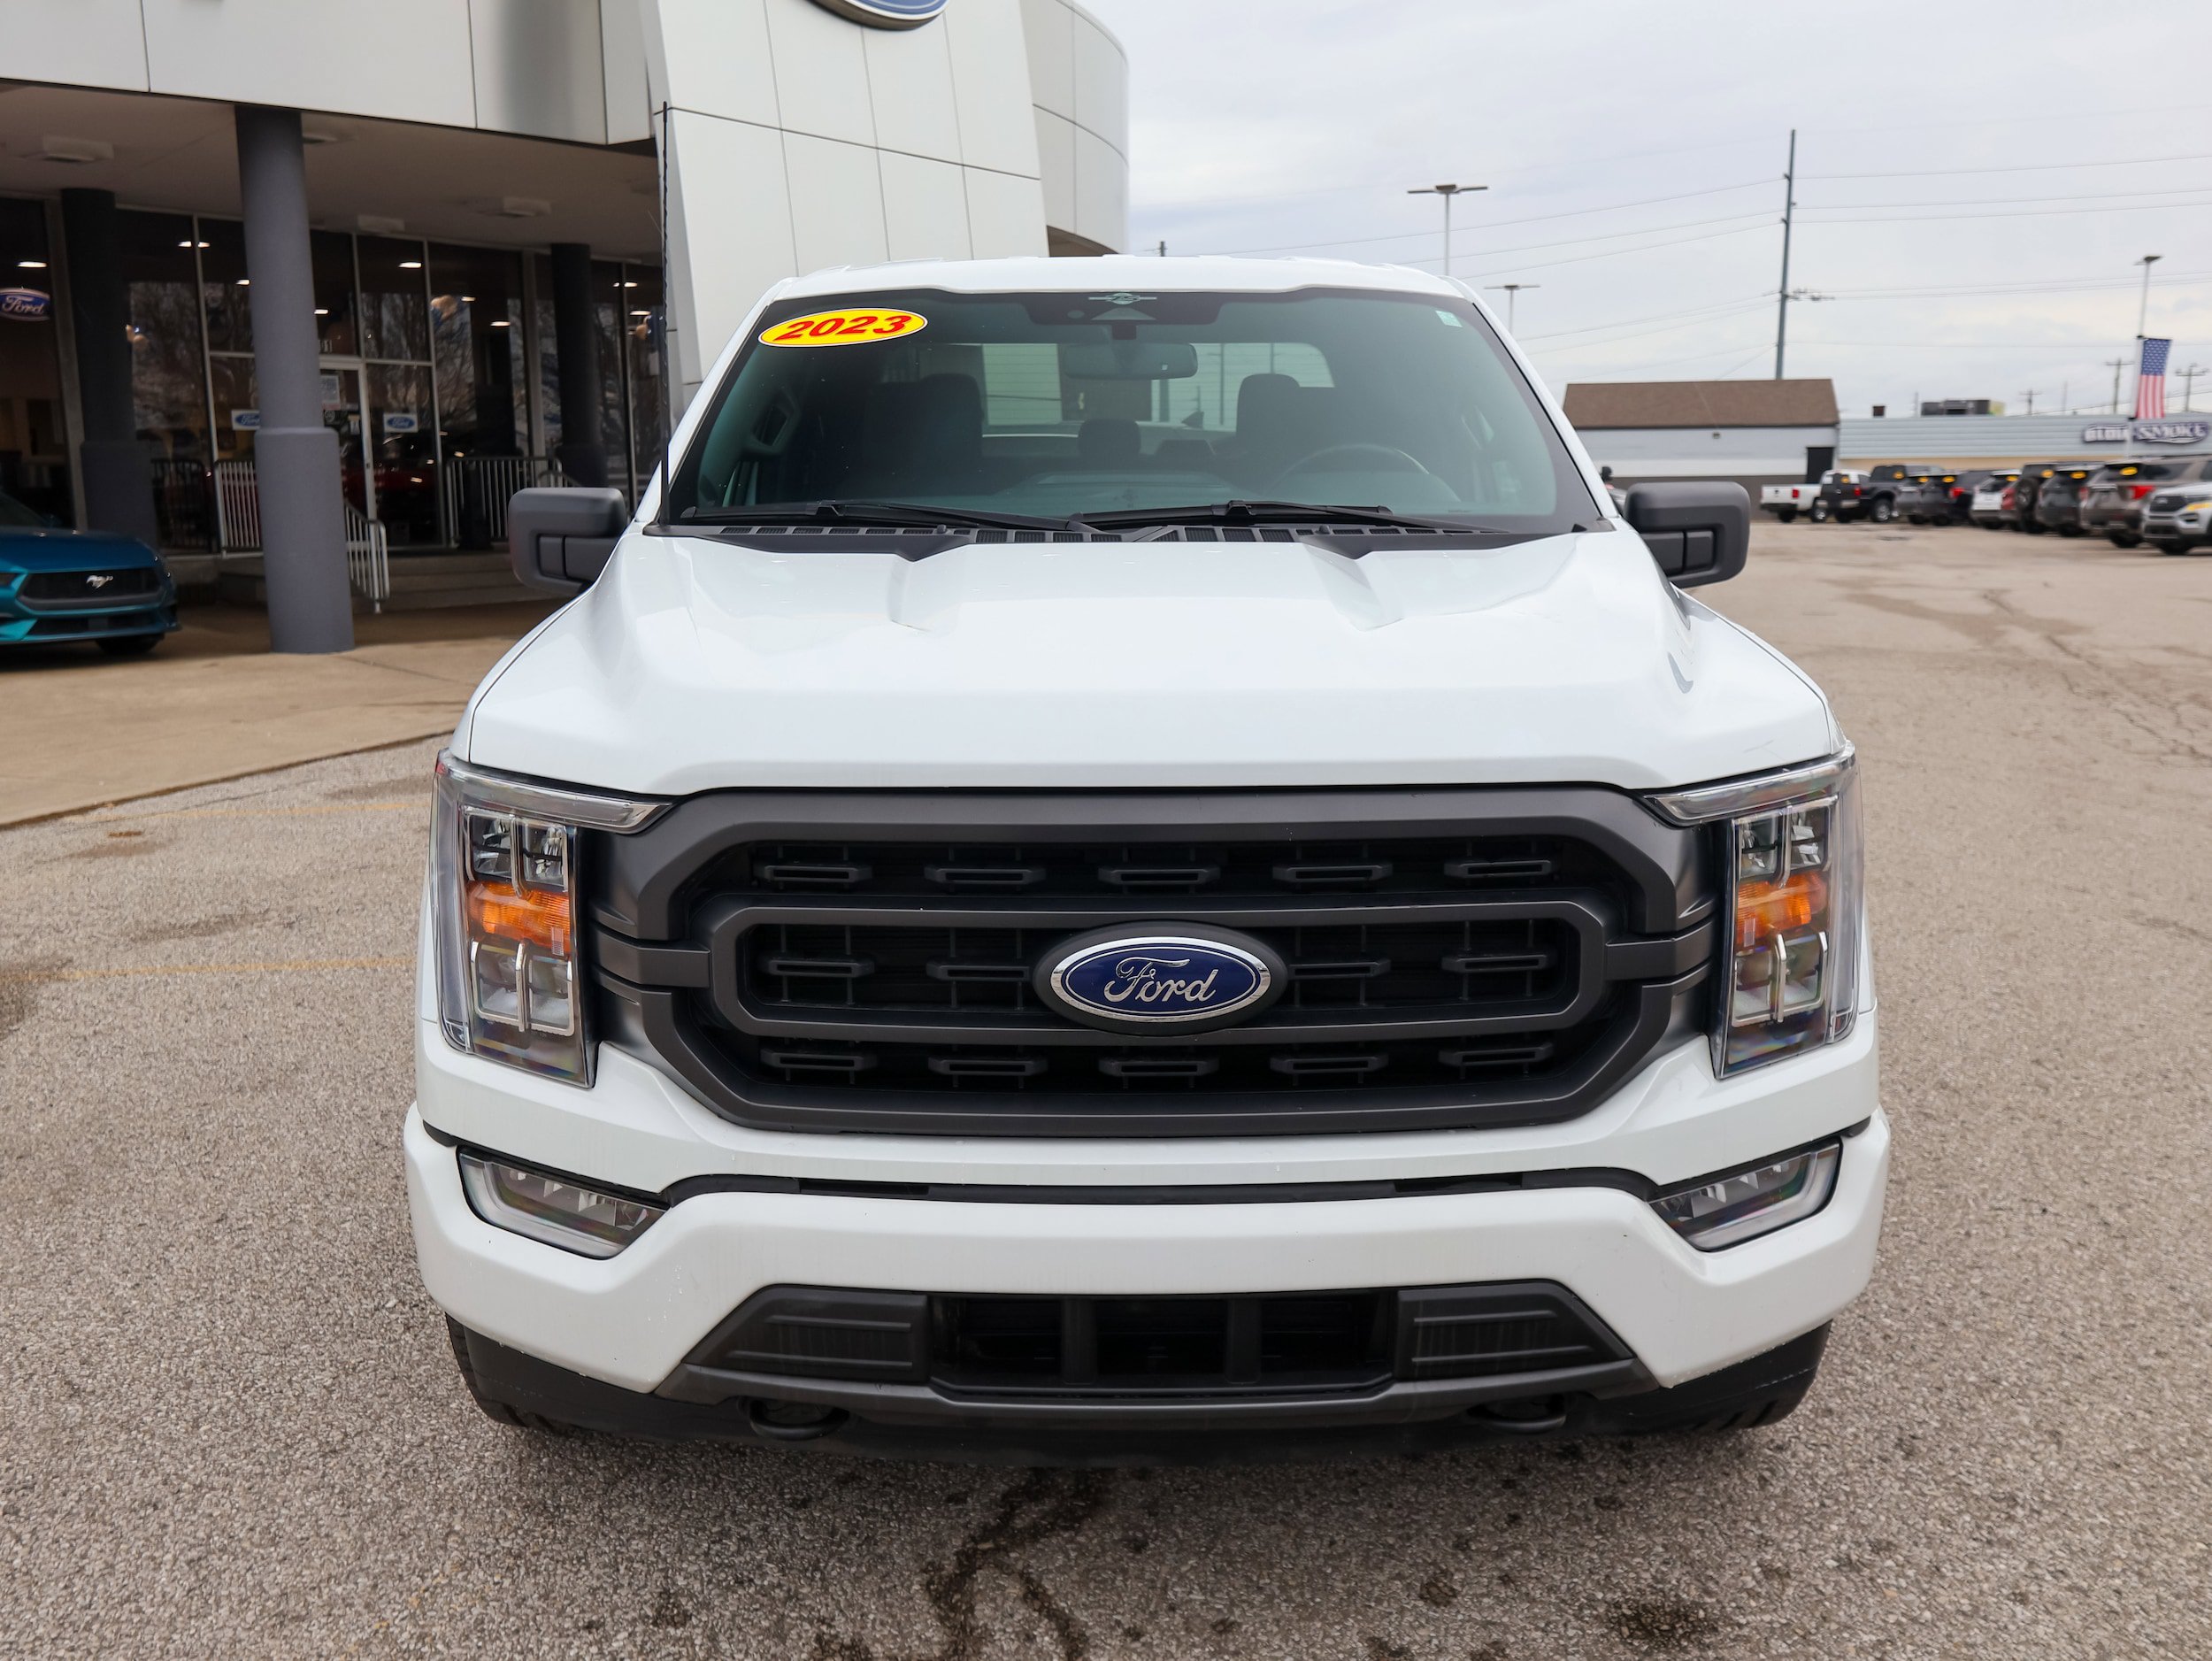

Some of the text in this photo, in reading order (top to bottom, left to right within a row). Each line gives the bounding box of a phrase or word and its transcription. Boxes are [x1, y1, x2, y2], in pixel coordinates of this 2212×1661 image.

[2, 296, 44, 314] Ford
[772, 315, 912, 342] 2023
[1103, 957, 1219, 1003] Ford
